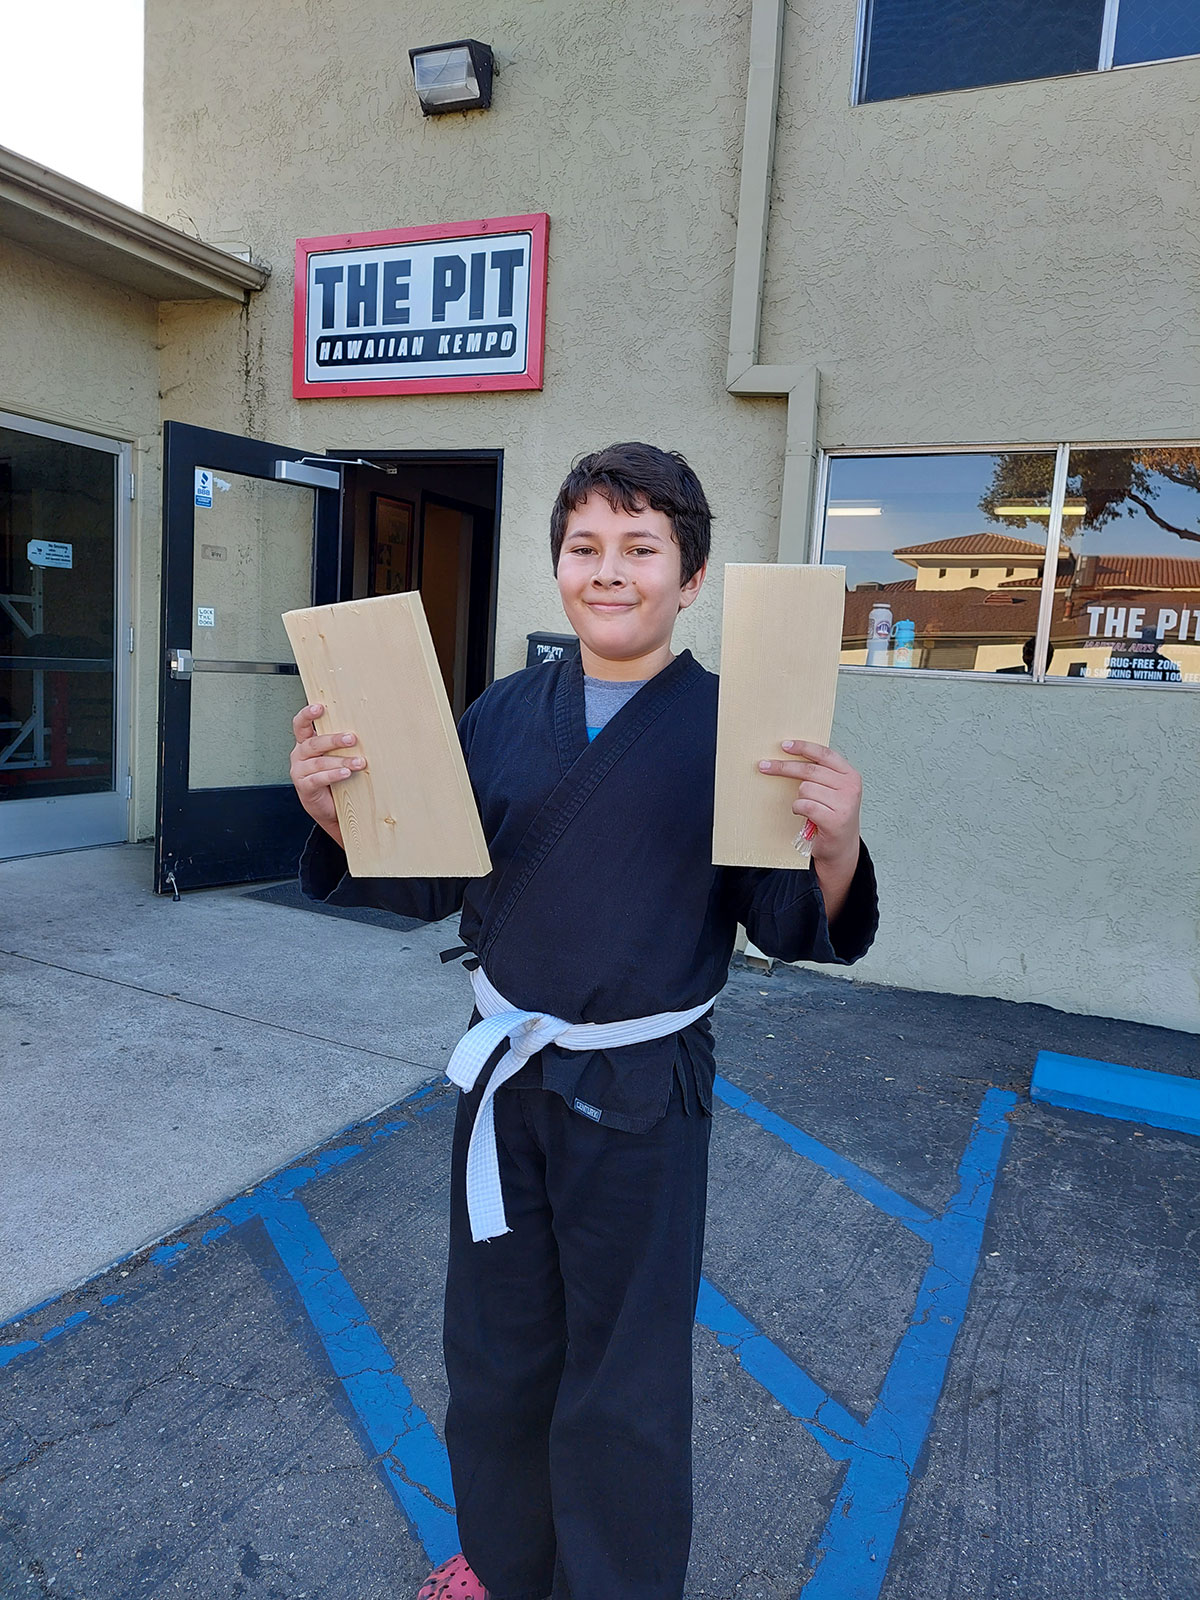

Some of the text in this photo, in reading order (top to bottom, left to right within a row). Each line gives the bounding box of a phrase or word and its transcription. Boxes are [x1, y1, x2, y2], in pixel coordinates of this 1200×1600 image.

[314, 248, 525, 330] THE PIT
[318, 330, 514, 361] HAWAIIAN KEMPO
[1086, 606, 1146, 639] THE
[1104, 657, 1182, 671] DRUG-FREE ZONE
[1133, 670, 1163, 681] WITHIN
[1165, 671, 1182, 682] 100
